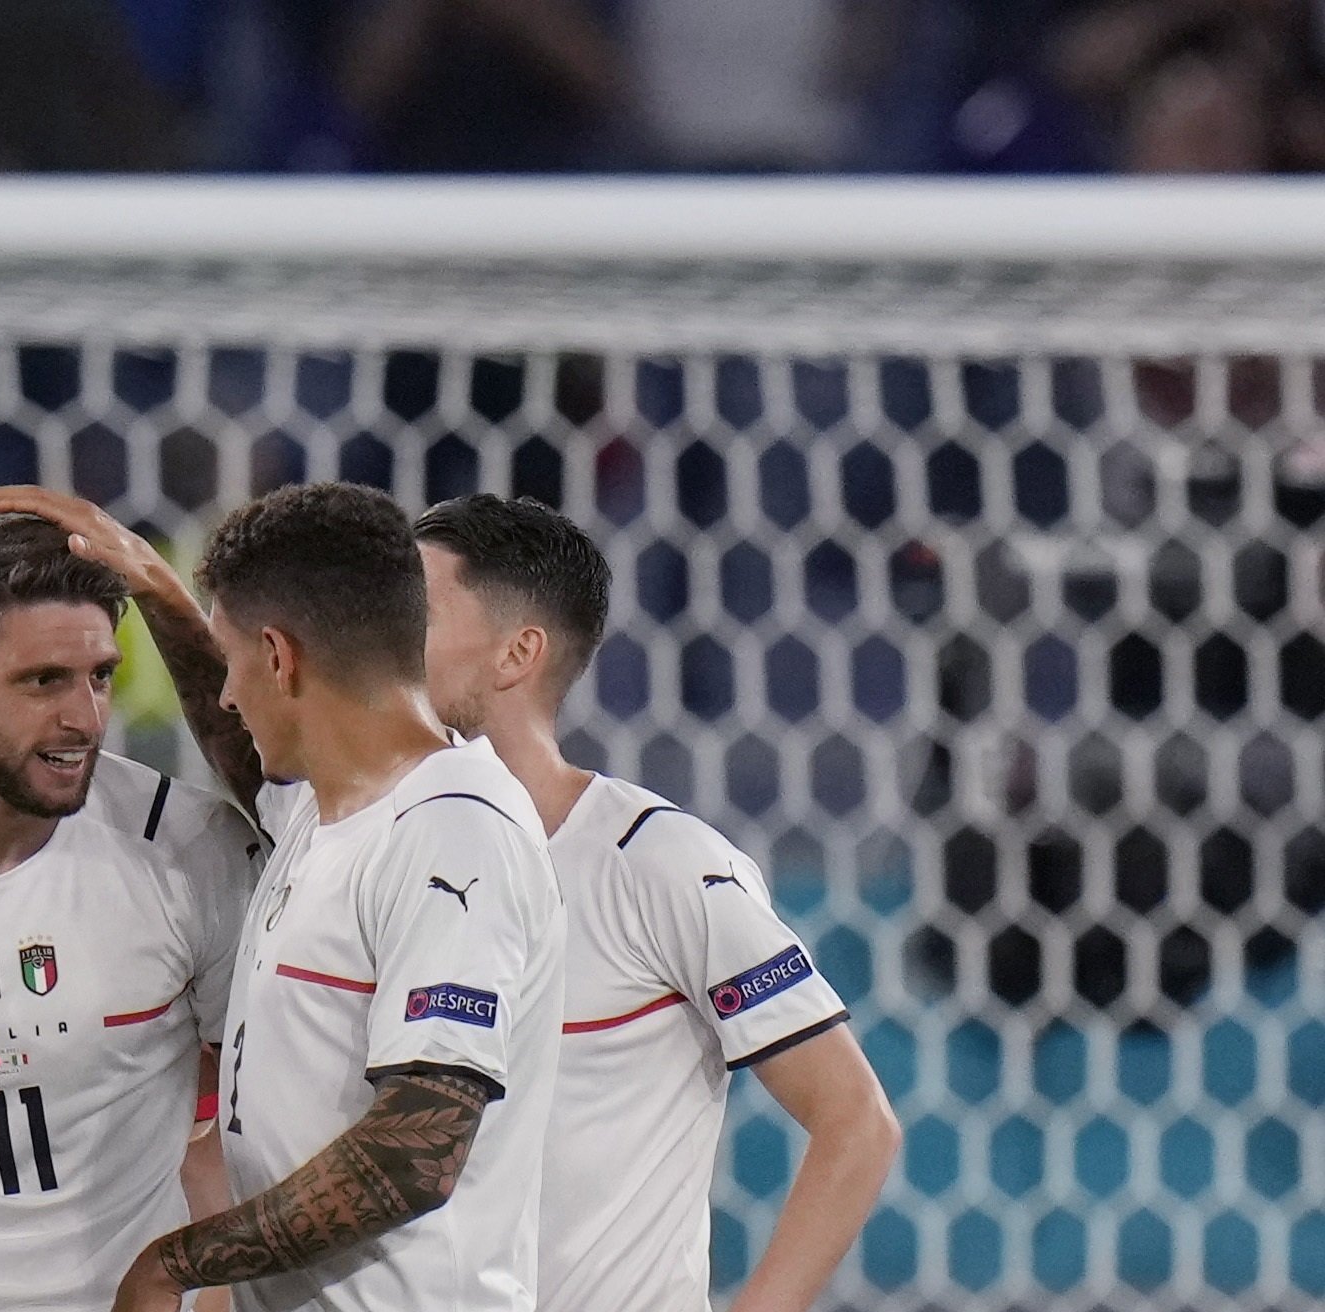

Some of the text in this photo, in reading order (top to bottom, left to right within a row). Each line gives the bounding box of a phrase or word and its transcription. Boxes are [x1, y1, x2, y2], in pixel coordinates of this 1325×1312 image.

[22, 949, 53, 959] ITALIA
[739, 953, 807, 999] RESPECT
[428, 991, 496, 1018] RESPECT
